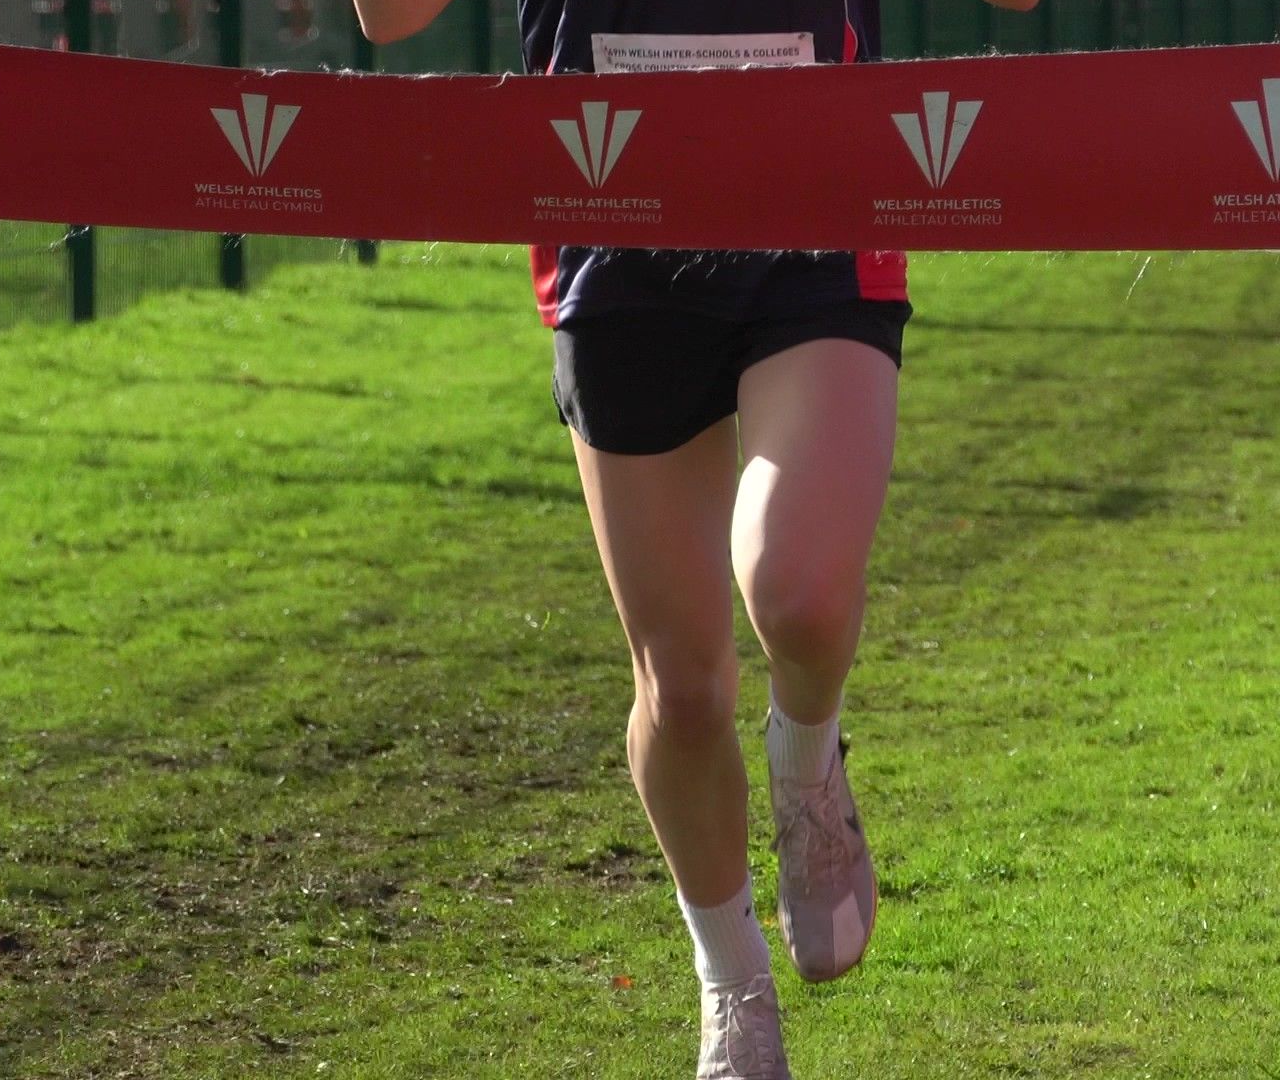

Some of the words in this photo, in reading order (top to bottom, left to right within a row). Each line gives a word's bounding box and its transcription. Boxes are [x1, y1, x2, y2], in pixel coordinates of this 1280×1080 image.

[628, 48, 660, 59] WELSH
[662, 48, 741, 59] INTER-SCHOOLS
[743, 48, 750, 58] &
[753, 47, 800, 58] COLLEGES
[195, 184, 244, 195] WELSH
[247, 186, 322, 198] ATHLETICS
[195, 197, 268, 210] ATHLETAU
[272, 201, 323, 212] CYMRU
[534, 197, 582, 208] WELSH
[586, 198, 661, 209] ATHLETICS
[874, 200, 923, 210] WELSH
[926, 199, 1002, 210] ATHLETICS
[1214, 194, 1263, 206] WELSH
[534, 211, 607, 222] ATHLETAU
[611, 212, 662, 224] CYMRU
[874, 214, 946, 225] ATHLETAU
[951, 214, 1002, 225] CYMRU
